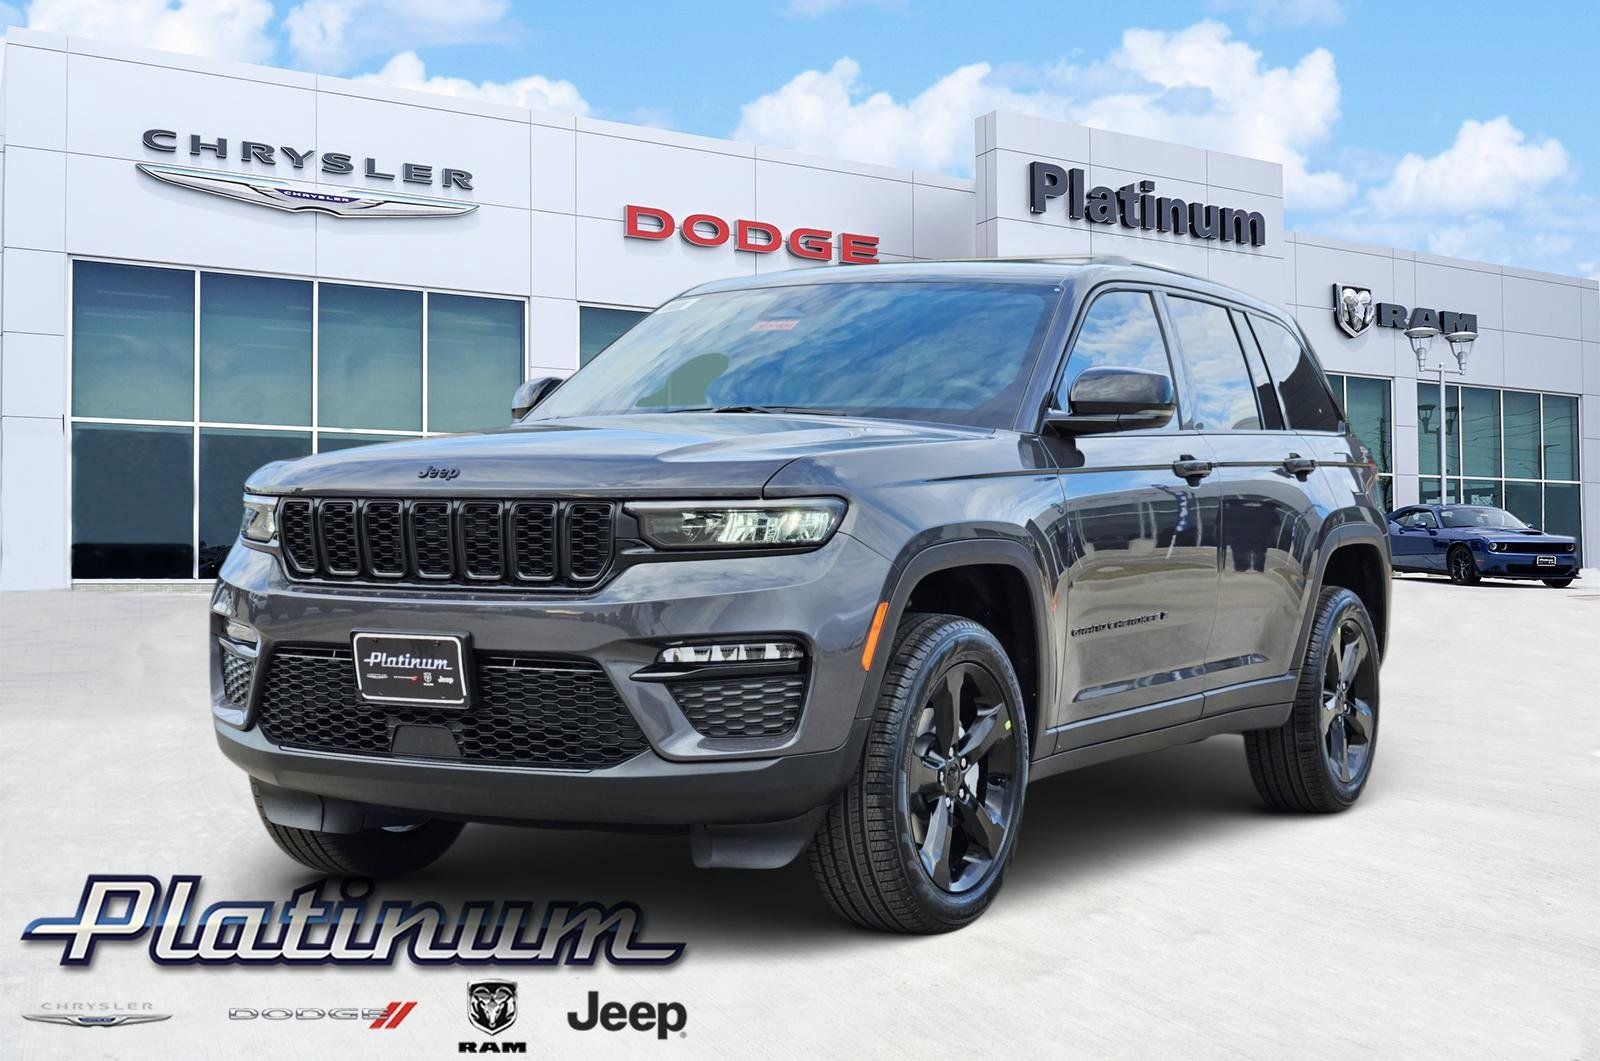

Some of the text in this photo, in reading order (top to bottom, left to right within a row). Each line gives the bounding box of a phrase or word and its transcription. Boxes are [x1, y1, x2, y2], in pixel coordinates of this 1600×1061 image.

[142, 129, 474, 190] CHRYSLER
[283, 190, 350, 203] CHRYSLER
[1029, 161, 1266, 246] Platinum
[623, 204, 880, 264] DODGE
[1376, 302, 1478, 334] RAM
[417, 465, 461, 481] Jeep
[363, 651, 454, 670] Platinum
